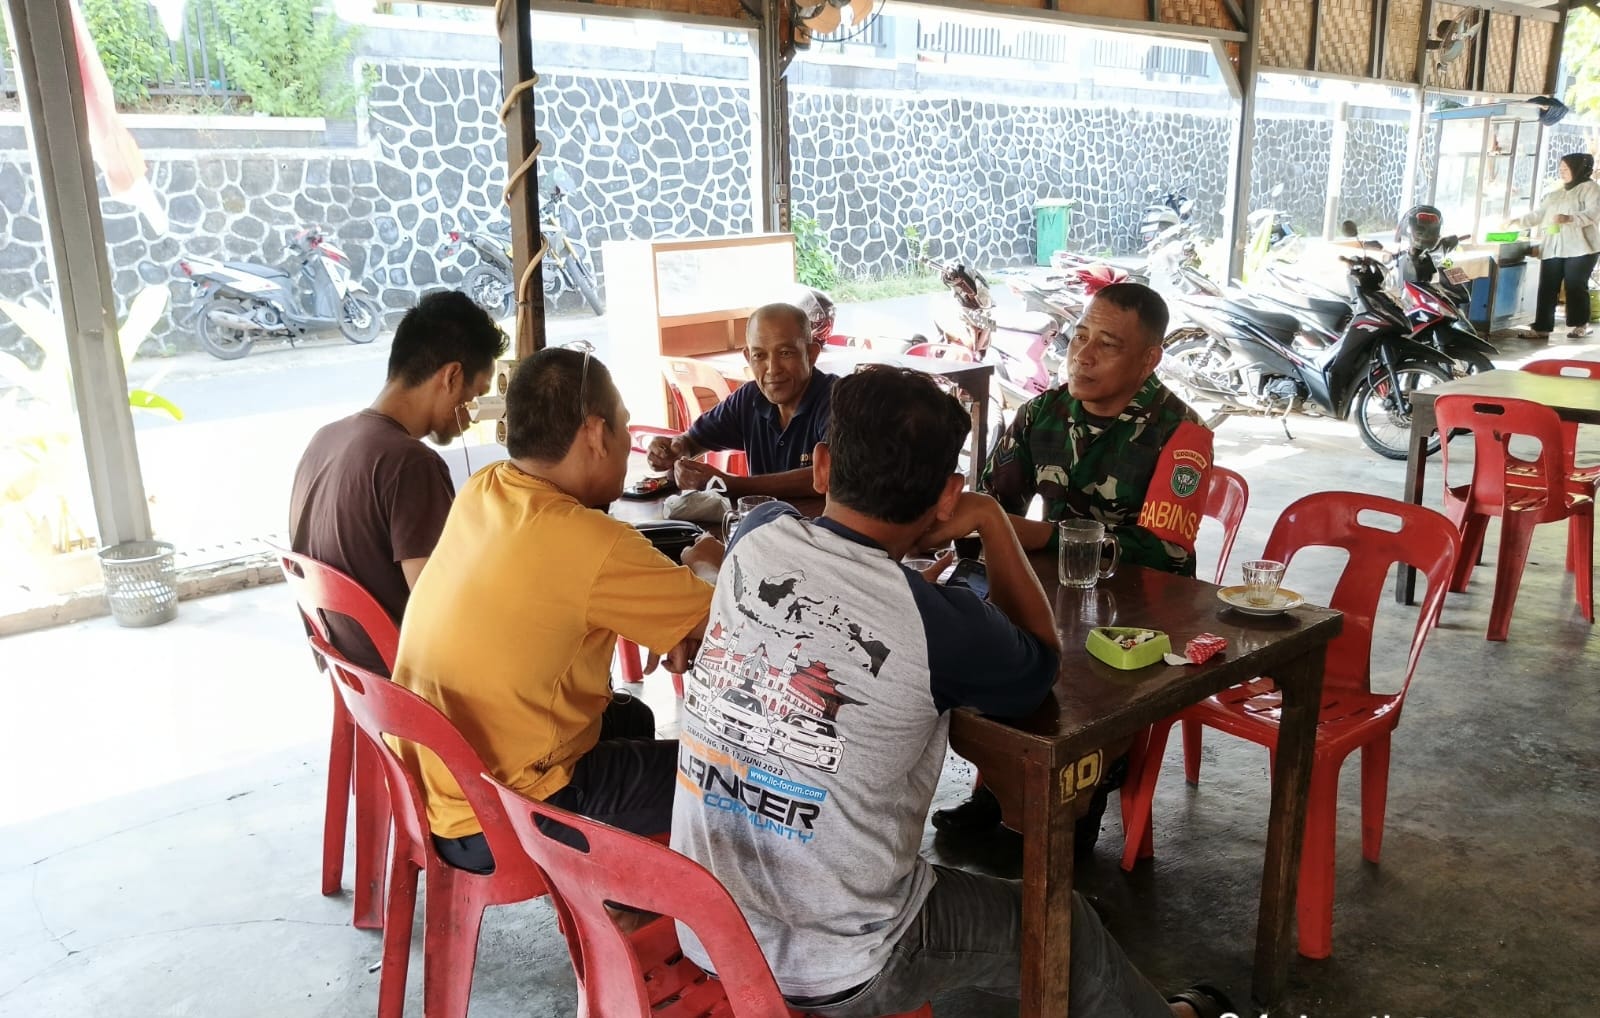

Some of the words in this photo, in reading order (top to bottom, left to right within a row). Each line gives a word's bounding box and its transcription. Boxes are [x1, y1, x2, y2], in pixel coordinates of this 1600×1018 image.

[1139, 500, 1197, 540] BABINS
[679, 744, 821, 830] LANCER
[742, 756, 761, 768] JUNI
[763, 763, 784, 776] 2023
[1062, 751, 1100, 797] 10
